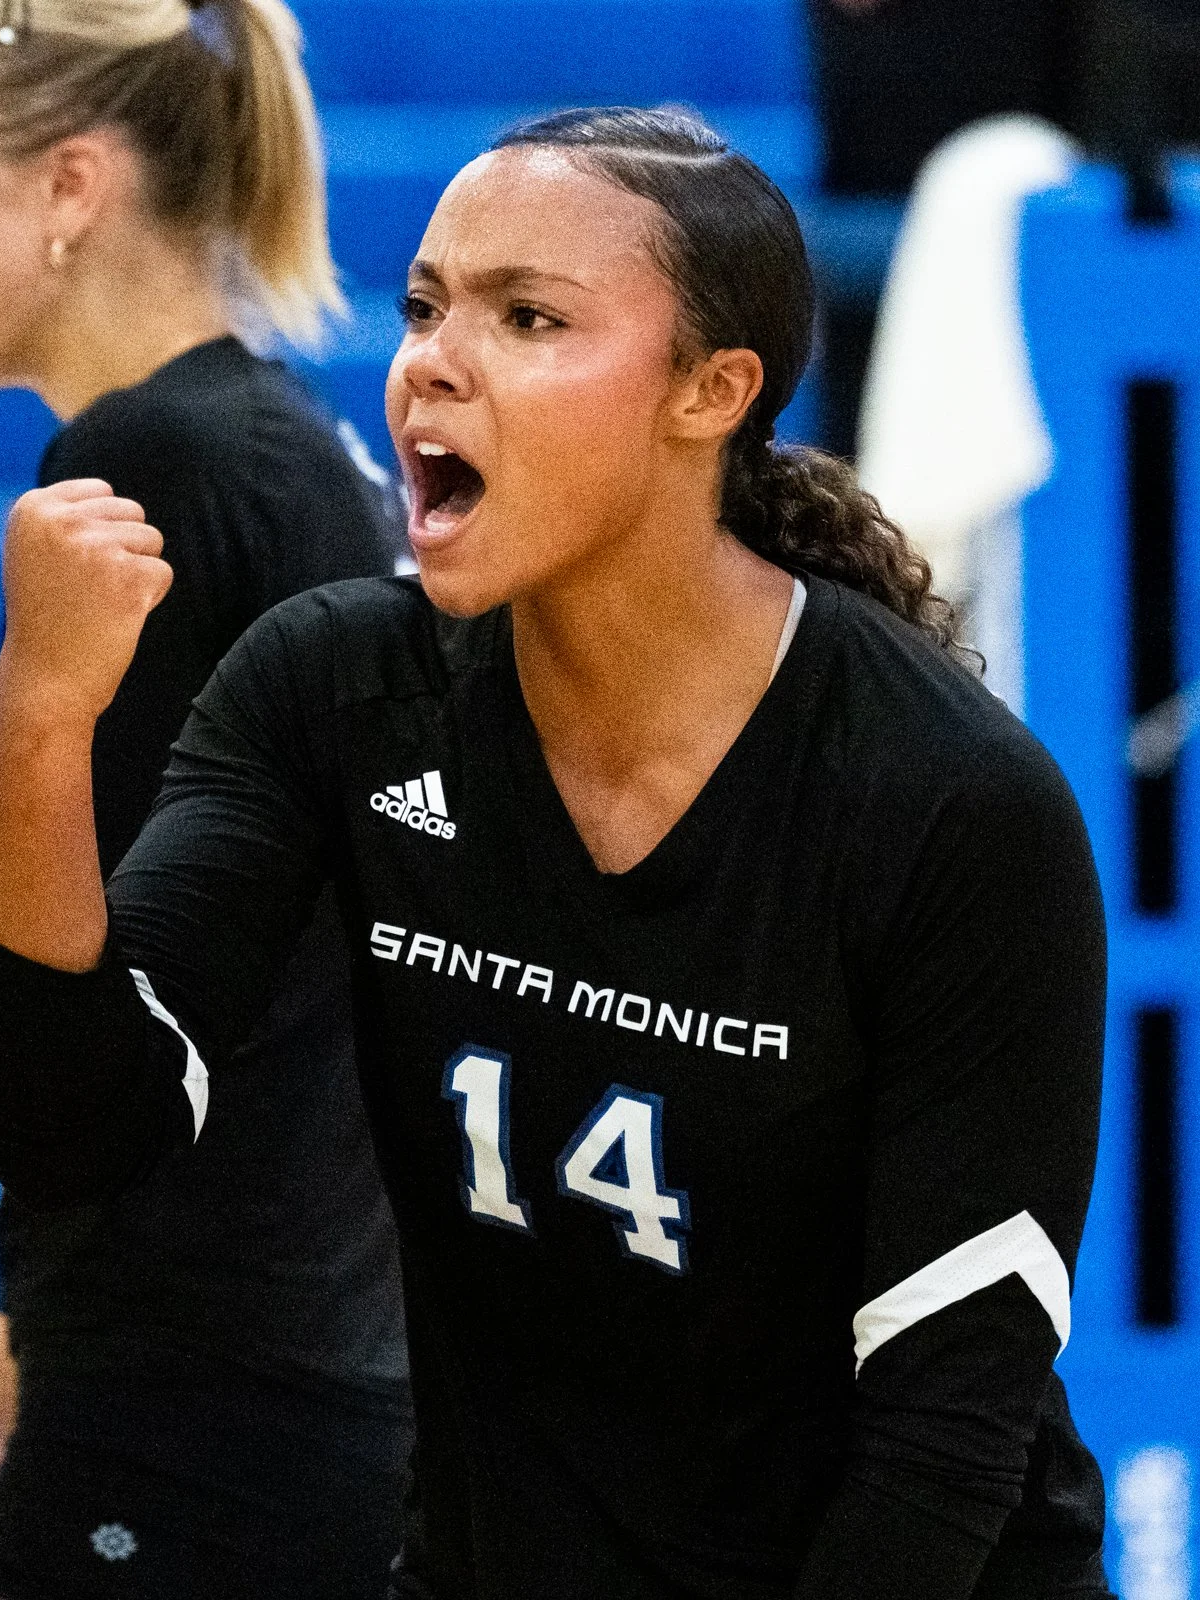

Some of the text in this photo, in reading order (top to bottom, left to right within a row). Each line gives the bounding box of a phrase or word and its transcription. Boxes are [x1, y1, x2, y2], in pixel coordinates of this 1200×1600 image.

[369, 791, 457, 840] adidas
[370, 921, 790, 1060] SANTA MONICA
[444, 1045, 689, 1275] 14
